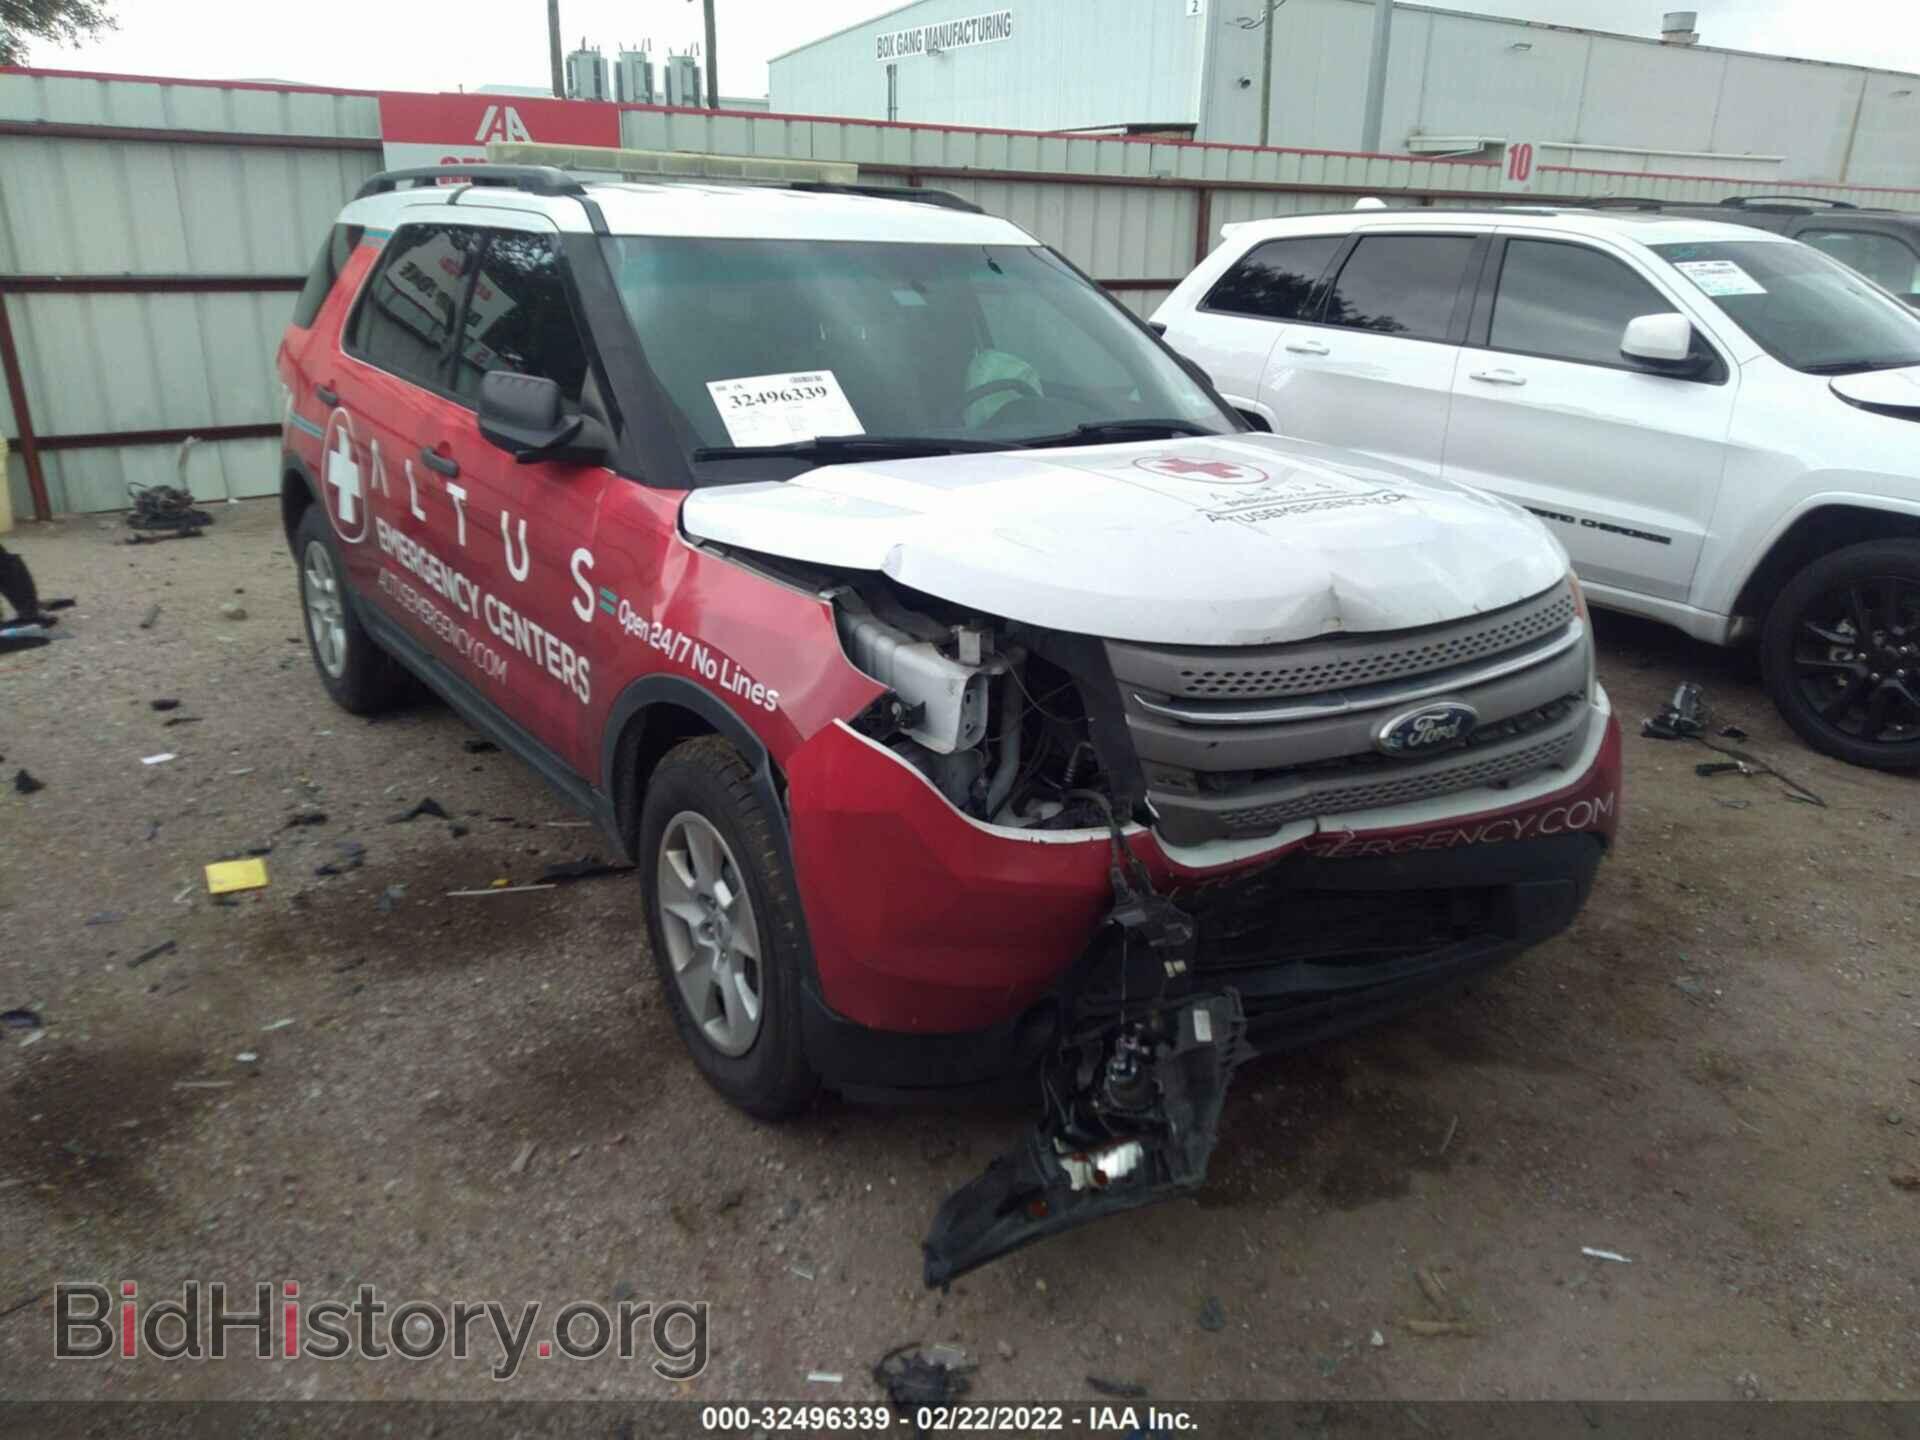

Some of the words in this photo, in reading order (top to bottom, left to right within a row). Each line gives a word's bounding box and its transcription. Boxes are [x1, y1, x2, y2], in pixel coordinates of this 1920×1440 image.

[877, 35, 895, 58] BOX
[896, 29, 922, 54] GANG
[925, 12, 1011, 50] MANUFACTURING
[1508, 143, 1533, 181] 10
[729, 386, 828, 409] 32496339
[376, 516, 481, 619] EMERGENCY
[484, 594, 591, 704] CENTERS
[618, 599, 649, 642] Open
[650, 621, 691, 663] 24/7
[691, 643, 718, 680] No
[719, 658, 781, 712] Lines
[1407, 712, 1462, 746] Ford
